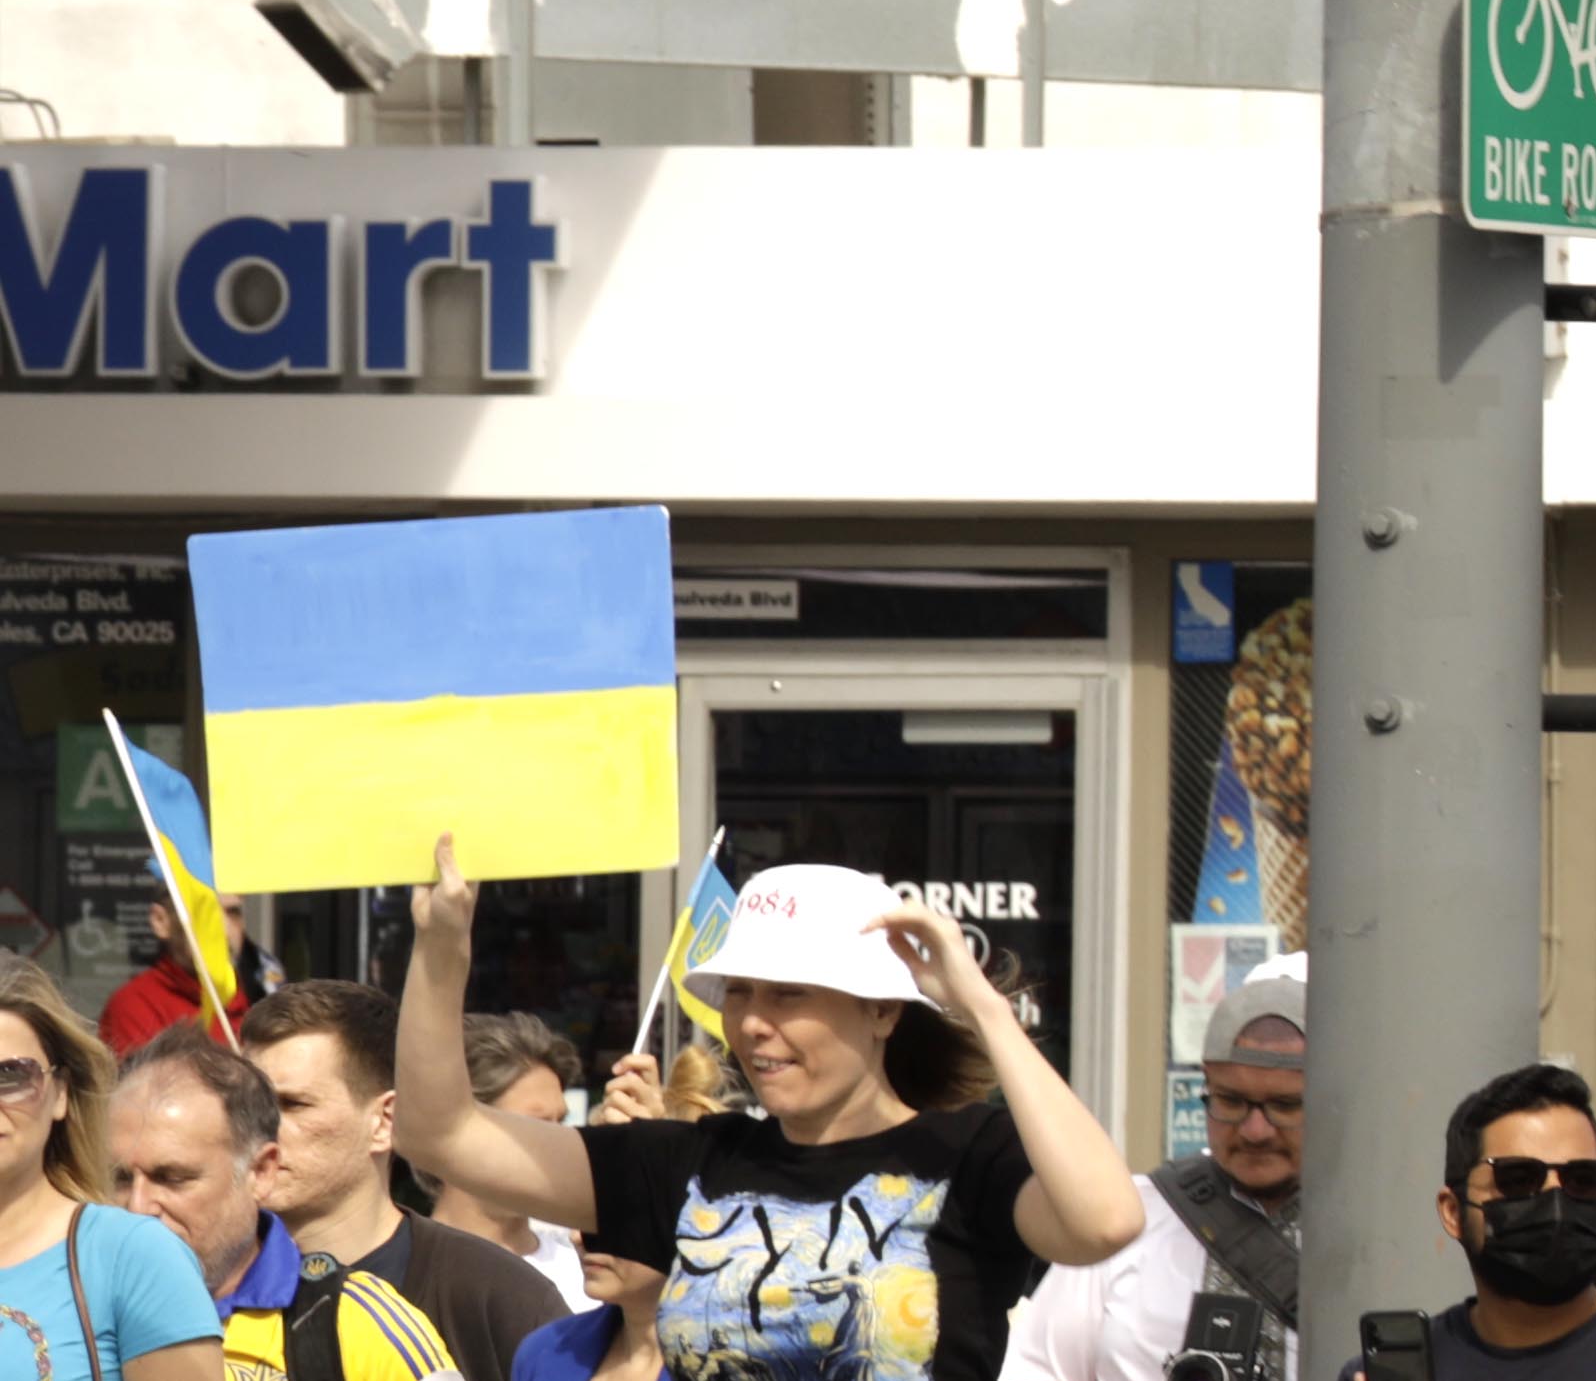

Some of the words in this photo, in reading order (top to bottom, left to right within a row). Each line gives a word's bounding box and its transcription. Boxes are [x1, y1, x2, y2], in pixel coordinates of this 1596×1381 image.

[1483, 134, 1551, 207] BIKE
[0, 164, 562, 379] Mart
[75, 588, 132, 613] Blvd.
[749, 589, 792, 608] Blvd
[51, 620, 89, 644] CA
[96, 619, 176, 645] 90025
[73, 749, 129, 810] A
[734, 888, 798, 919] 1984
[884, 880, 1040, 920] ORNER
